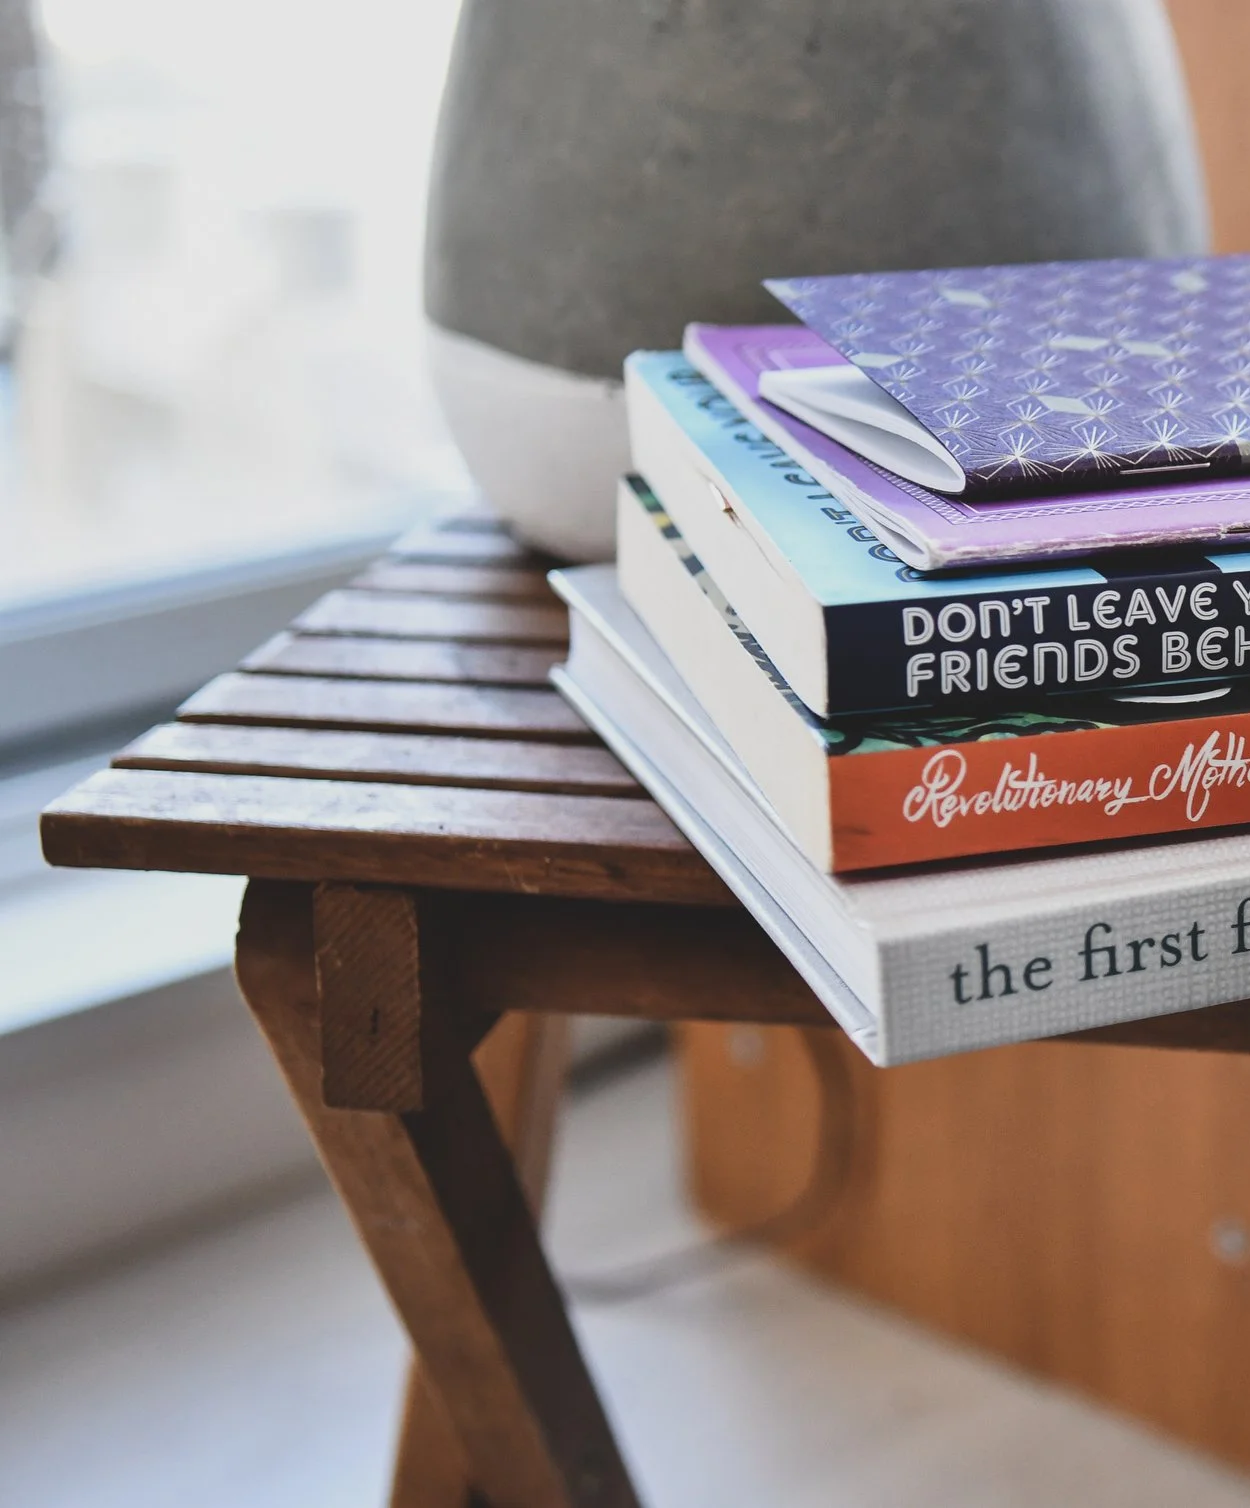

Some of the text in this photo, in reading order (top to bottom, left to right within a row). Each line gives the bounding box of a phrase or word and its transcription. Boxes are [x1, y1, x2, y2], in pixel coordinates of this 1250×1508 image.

[902, 594, 1051, 646] DON'T
[1067, 582, 1219, 632] LEAVE
[906, 634, 1141, 698] FRIENDS
[902, 748, 1152, 828] Revolutionary
[949, 943, 1053, 1005] the
[1078, 922, 1209, 982] first
